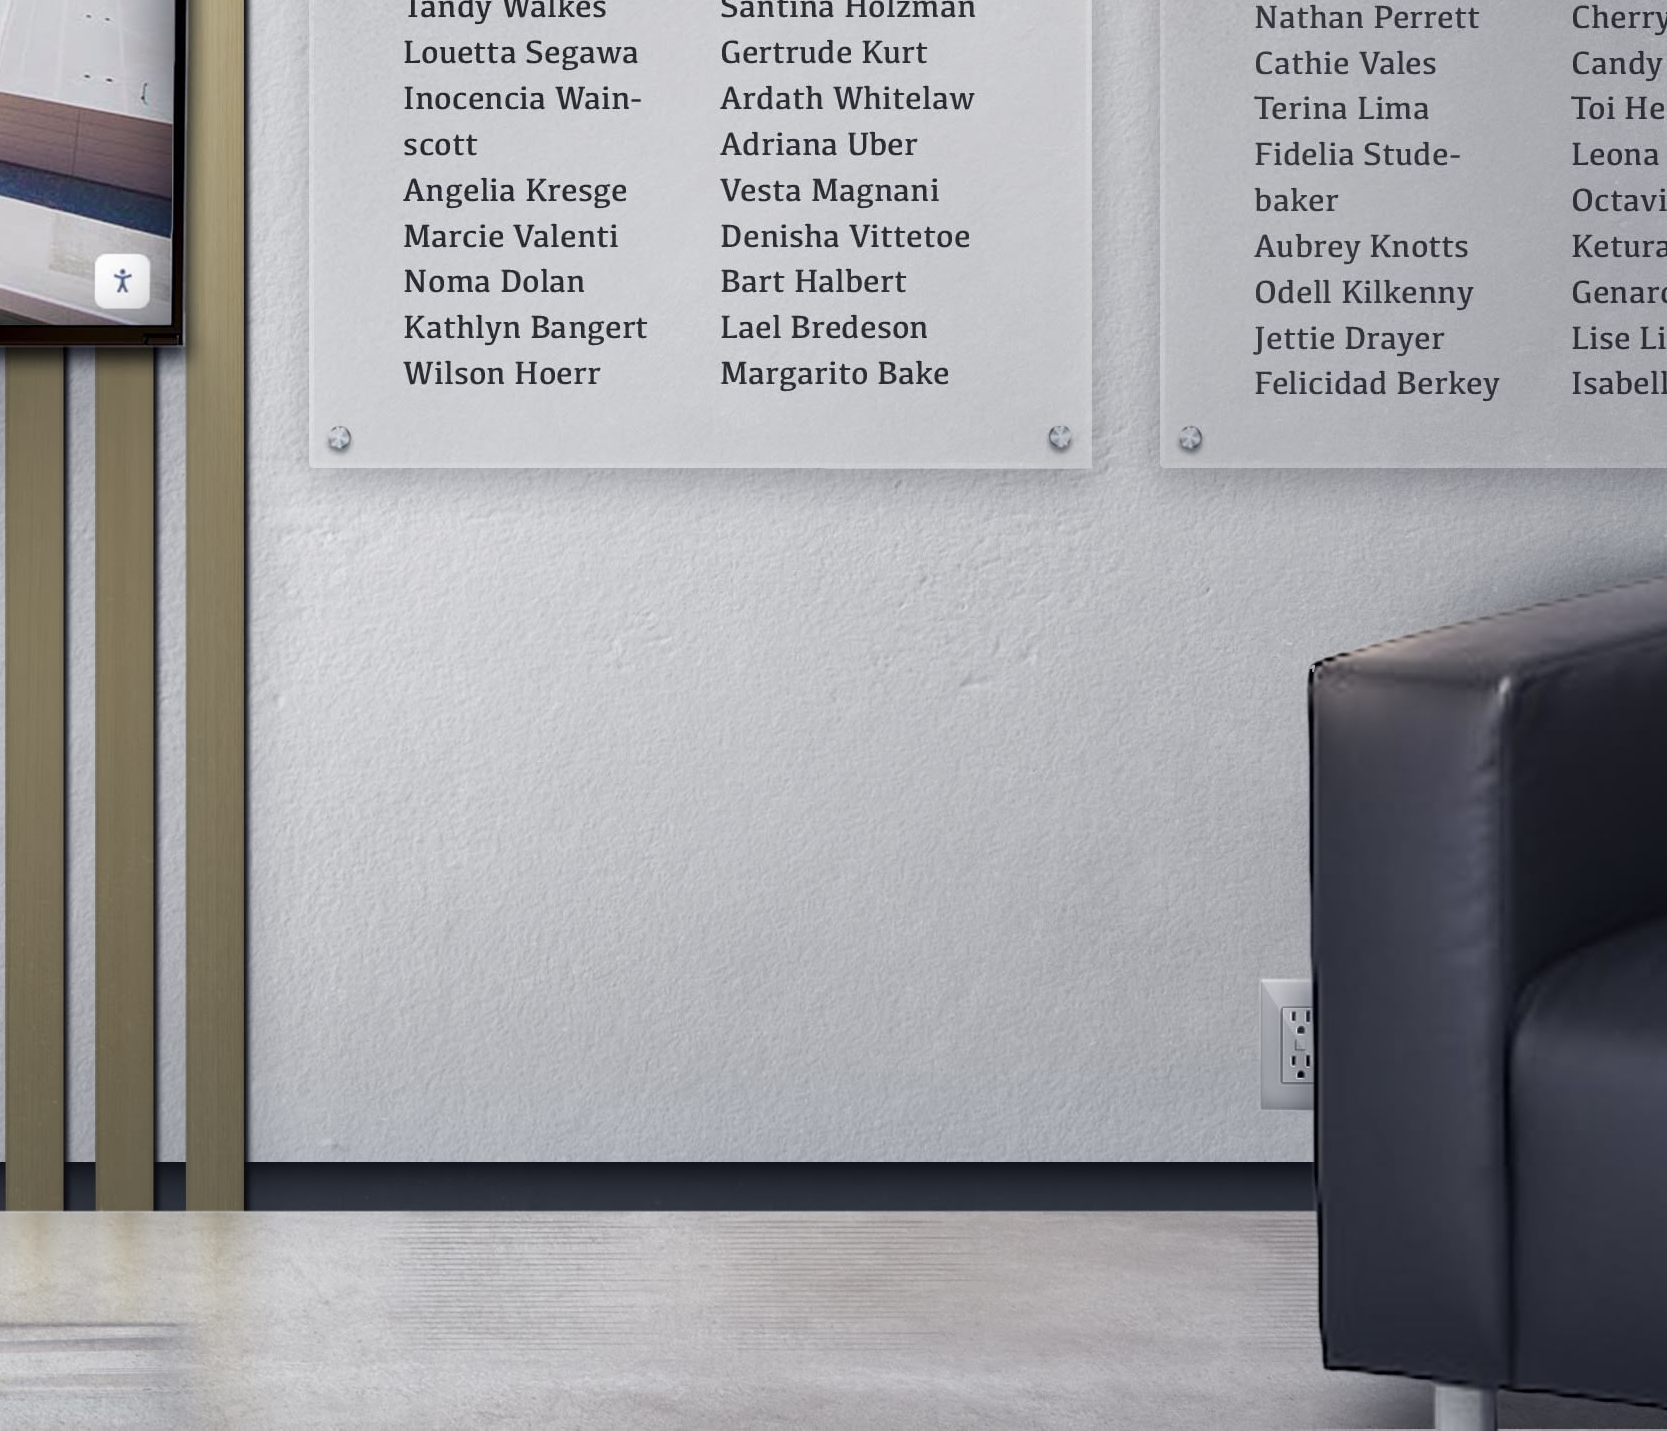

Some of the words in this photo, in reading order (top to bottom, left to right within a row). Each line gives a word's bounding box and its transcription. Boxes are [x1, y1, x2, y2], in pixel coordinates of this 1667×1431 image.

[1254, 4, 1364, 29] Nathan
[1373, 4, 1480, 29] Perrett
[1572, 4, 1667, 36] Cherry
[403, 39, 517, 65] Louetta
[525, 39, 639, 72] Segawa
[1572, 50, 1664, 82] Candy
[719, 84, 824, 111] Ardath
[832, 84, 976, 111] Whitelaw
[1253, 95, 1348, 121] Terina
[1357, 95, 1430, 121] Lima
[403, 133, 479, 157] scott
[1571, 141, 1660, 167] Leona
[719, 177, 802, 203] Vesta
[811, 177, 940, 209] Magnani
[1253, 187, 1339, 212] baker
[403, 223, 504, 249] Marcie
[512, 222, 619, 249] Valenti
[720, 268, 786, 294] Bart
[794, 267, 907, 294] Halbert
[1255, 279, 1332, 305] Odell
[1341, 279, 1475, 311] Kilkenny
[403, 313, 521, 347] Kathlyn
[530, 314, 648, 347] Bangert
[1571, 325, 1630, 351] Lise
[720, 360, 868, 393] Margarito
[877, 359, 949, 386] Bake
[1254, 369, 1387, 395] Felicidad
[1396, 370, 1501, 402] Berkey
